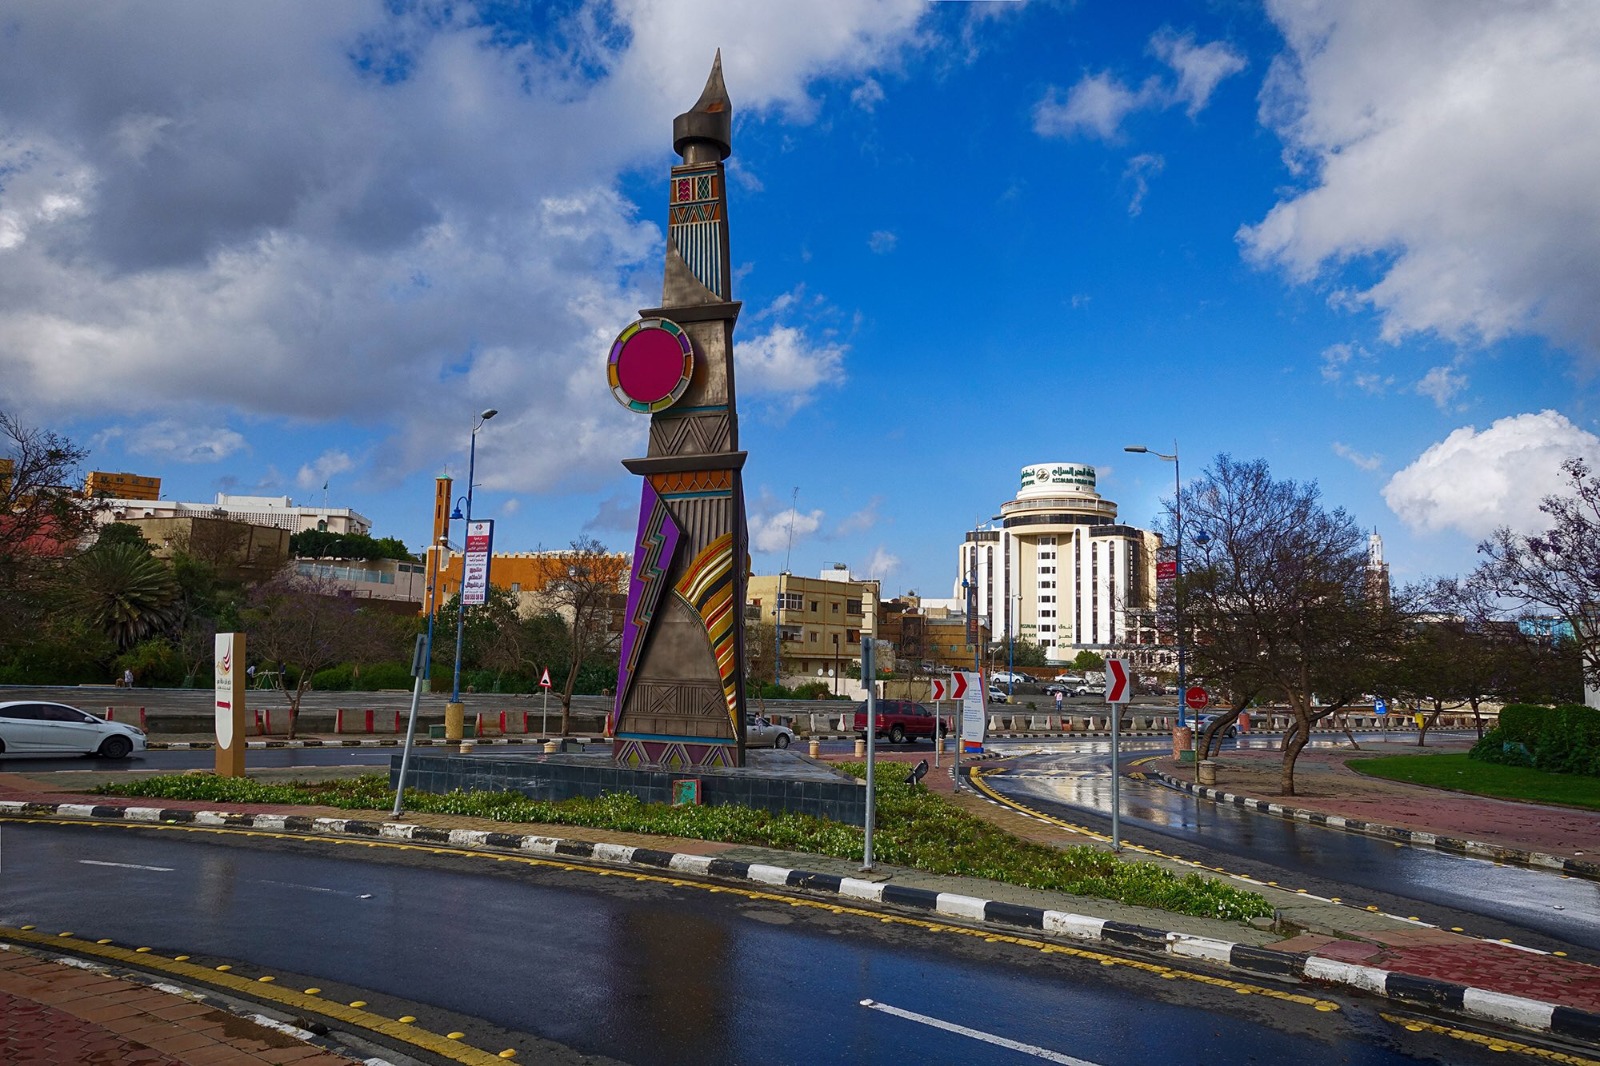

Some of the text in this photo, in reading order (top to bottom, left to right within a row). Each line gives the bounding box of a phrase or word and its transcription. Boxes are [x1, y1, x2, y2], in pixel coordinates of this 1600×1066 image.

[1052, 467, 1074, 476] السلام
[1188, 694, 1206, 702] قف
[1375, 700, 1384, 711] P
